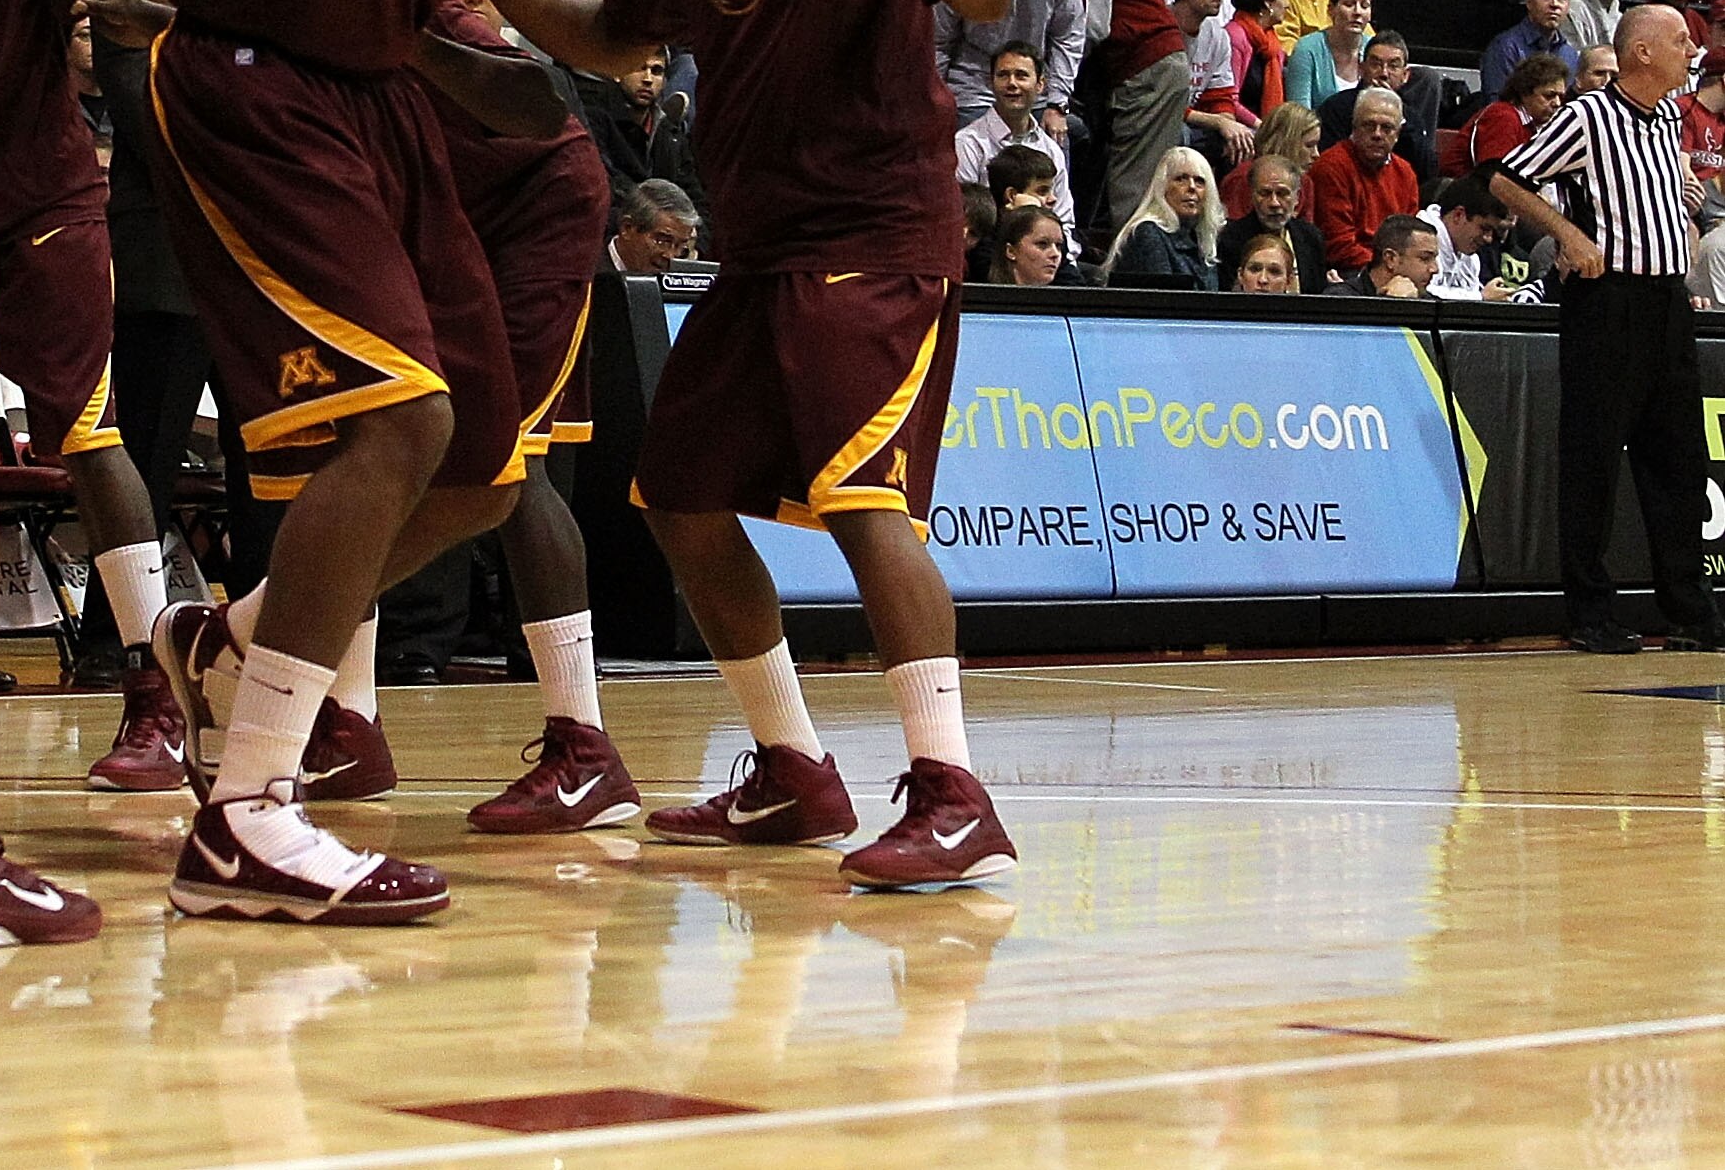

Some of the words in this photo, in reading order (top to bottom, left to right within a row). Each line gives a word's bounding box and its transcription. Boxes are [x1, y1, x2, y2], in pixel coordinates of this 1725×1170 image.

[682, 276, 711, 288] Wagner
[940, 387, 1390, 451] erThanPeco.com
[927, 504, 1104, 552] OMPARE,
[1112, 502, 1210, 543] SHOP
[1221, 503, 1245, 542] &
[1253, 502, 1347, 543] SAVE
